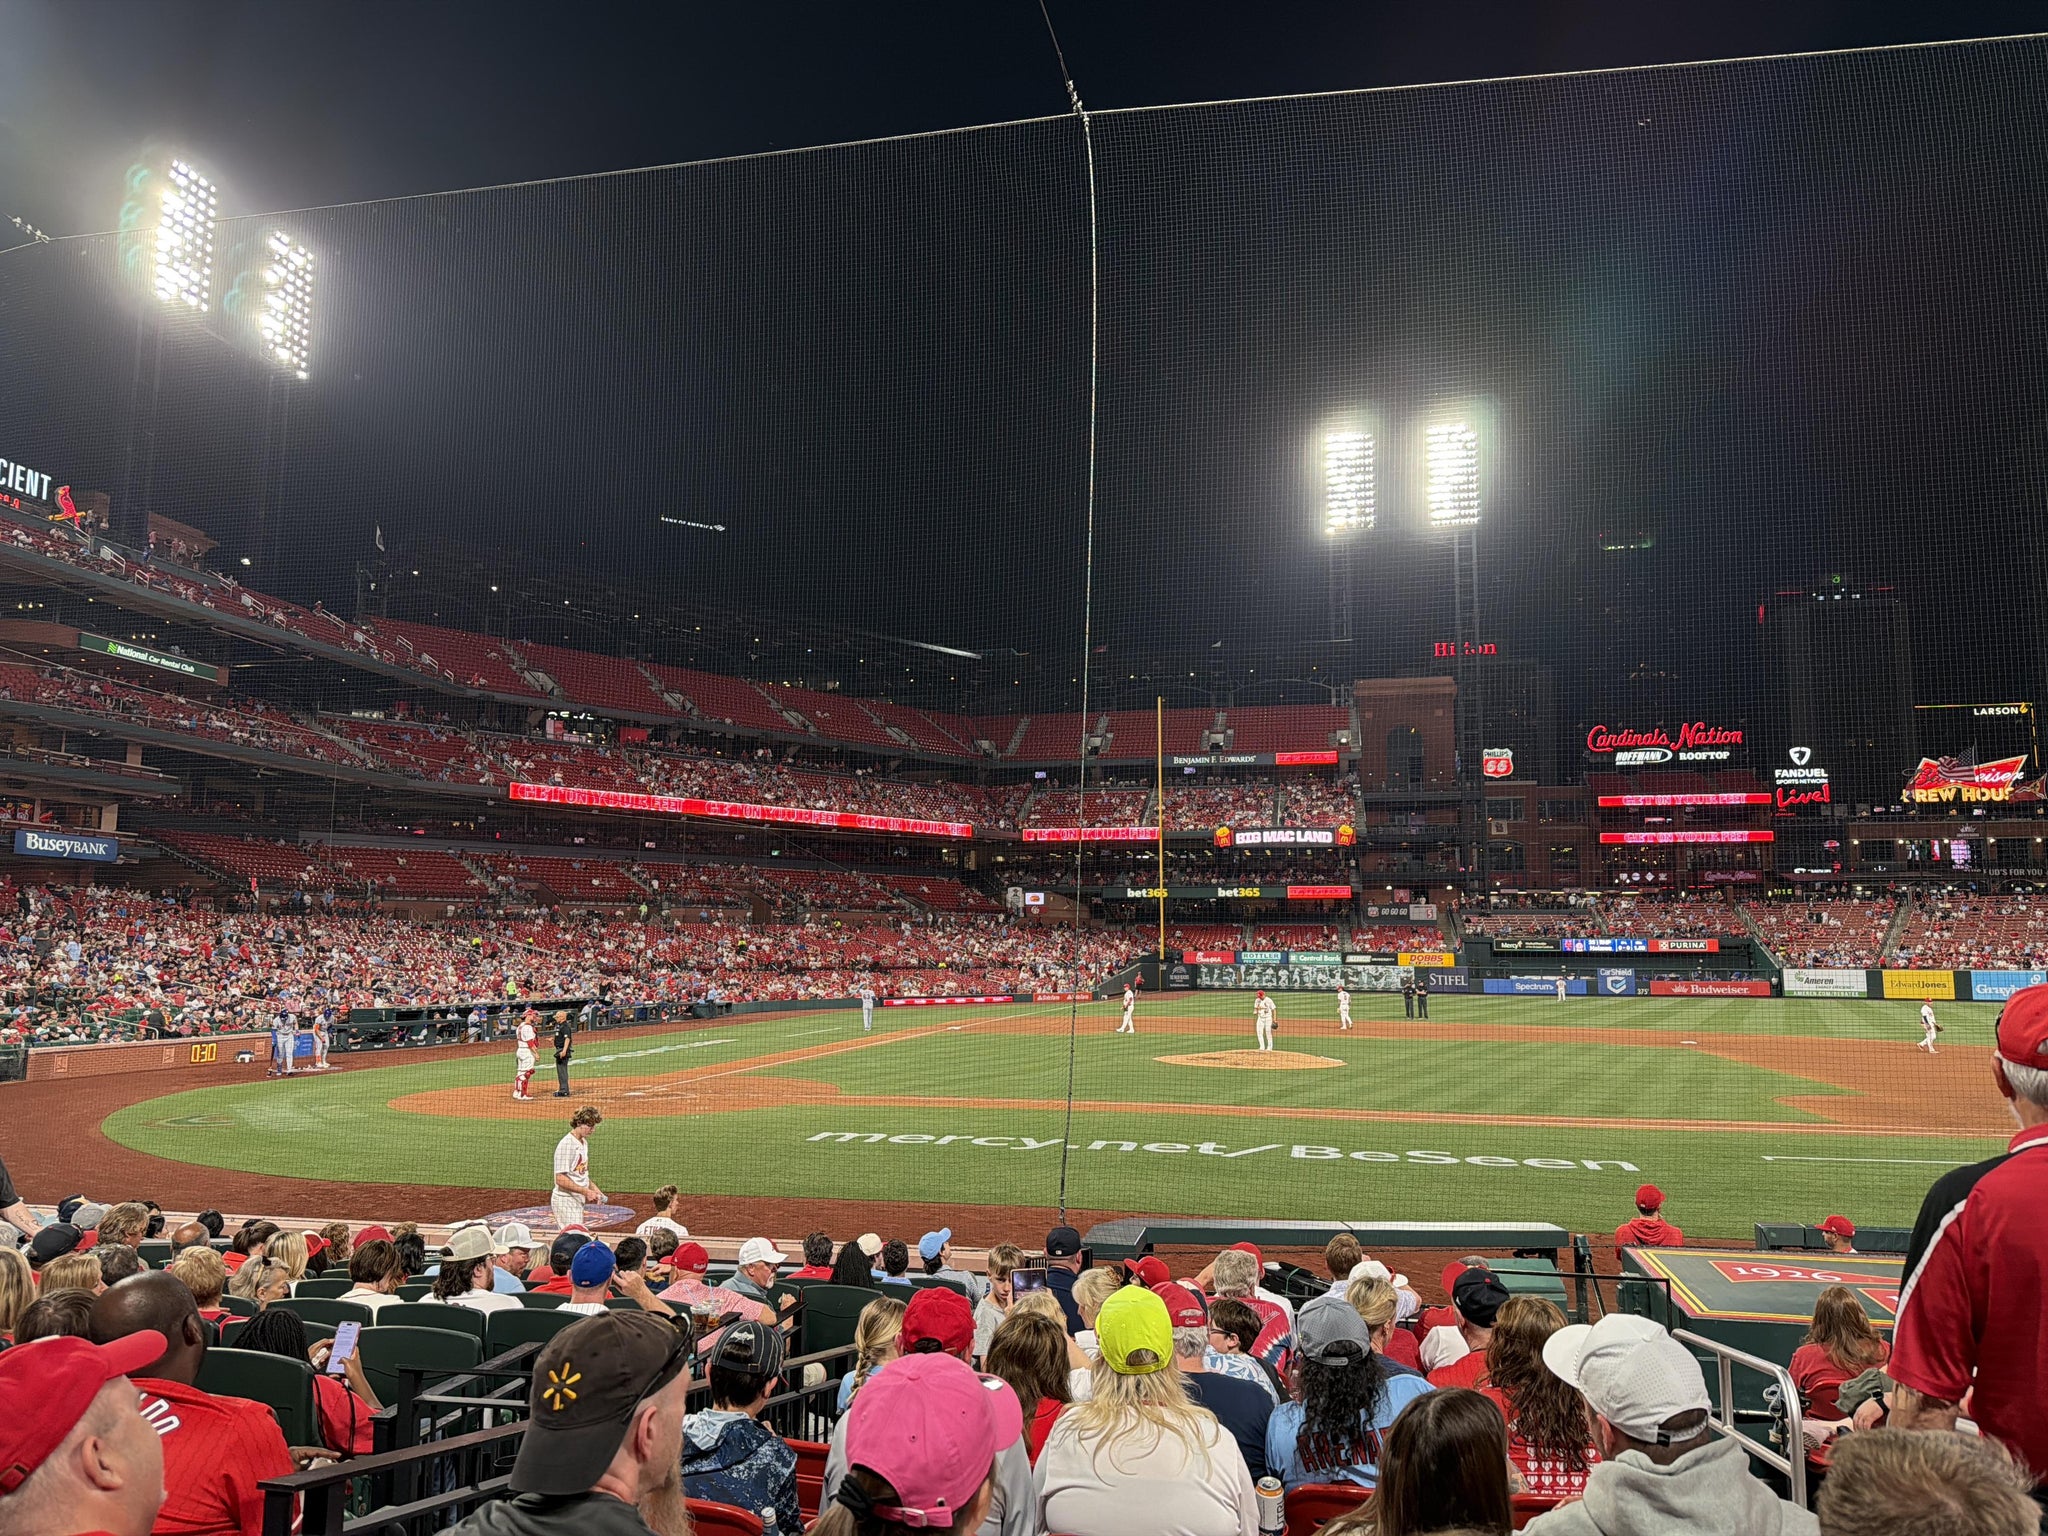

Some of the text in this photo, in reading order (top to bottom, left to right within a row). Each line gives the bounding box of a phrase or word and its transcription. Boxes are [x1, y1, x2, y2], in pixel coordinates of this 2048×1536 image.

[117, 645, 195, 673] National Car Rental Club
[1974, 706, 2019, 716] LARSON
[1587, 721, 1743, 752] Cardinals Nation
[1173, 756, 1209, 765] BENJAMIN
[1219, 755, 1255, 763] EDWARDS
[1615, 751, 1663, 761] HOFFMANN
[1679, 751, 1730, 761] ROOFTOP
[1487, 760, 1508, 772] 66
[1774, 768, 1828, 778] FANDUEL
[1777, 784, 1830, 807] Live!
[650, 796, 685, 813] FEET
[811, 810, 840, 826] FEET
[1235, 830, 1333, 844] BIG MAC LAND
[2009, 868, 2025, 876] FOR
[2026, 868, 2043, 876] YOU
[1127, 888, 1168, 898] bet365
[1217, 887, 1260, 898] bet365
[1501, 942, 1518, 950] Mercy
[1299, 954, 1322, 962] Central
[1323, 954, 1341, 962] Bank
[1410, 954, 1444, 962] DOBBS
[1599, 968, 1633, 976] CarShield
[1429, 973, 1468, 986] STIFEL
[1804, 977, 1834, 985] Ameren
[1515, 982, 1550, 992] Spectrum
[1731, 1266, 1842, 1282] 1926
[1297, 1428, 1390, 1473] ARENA
